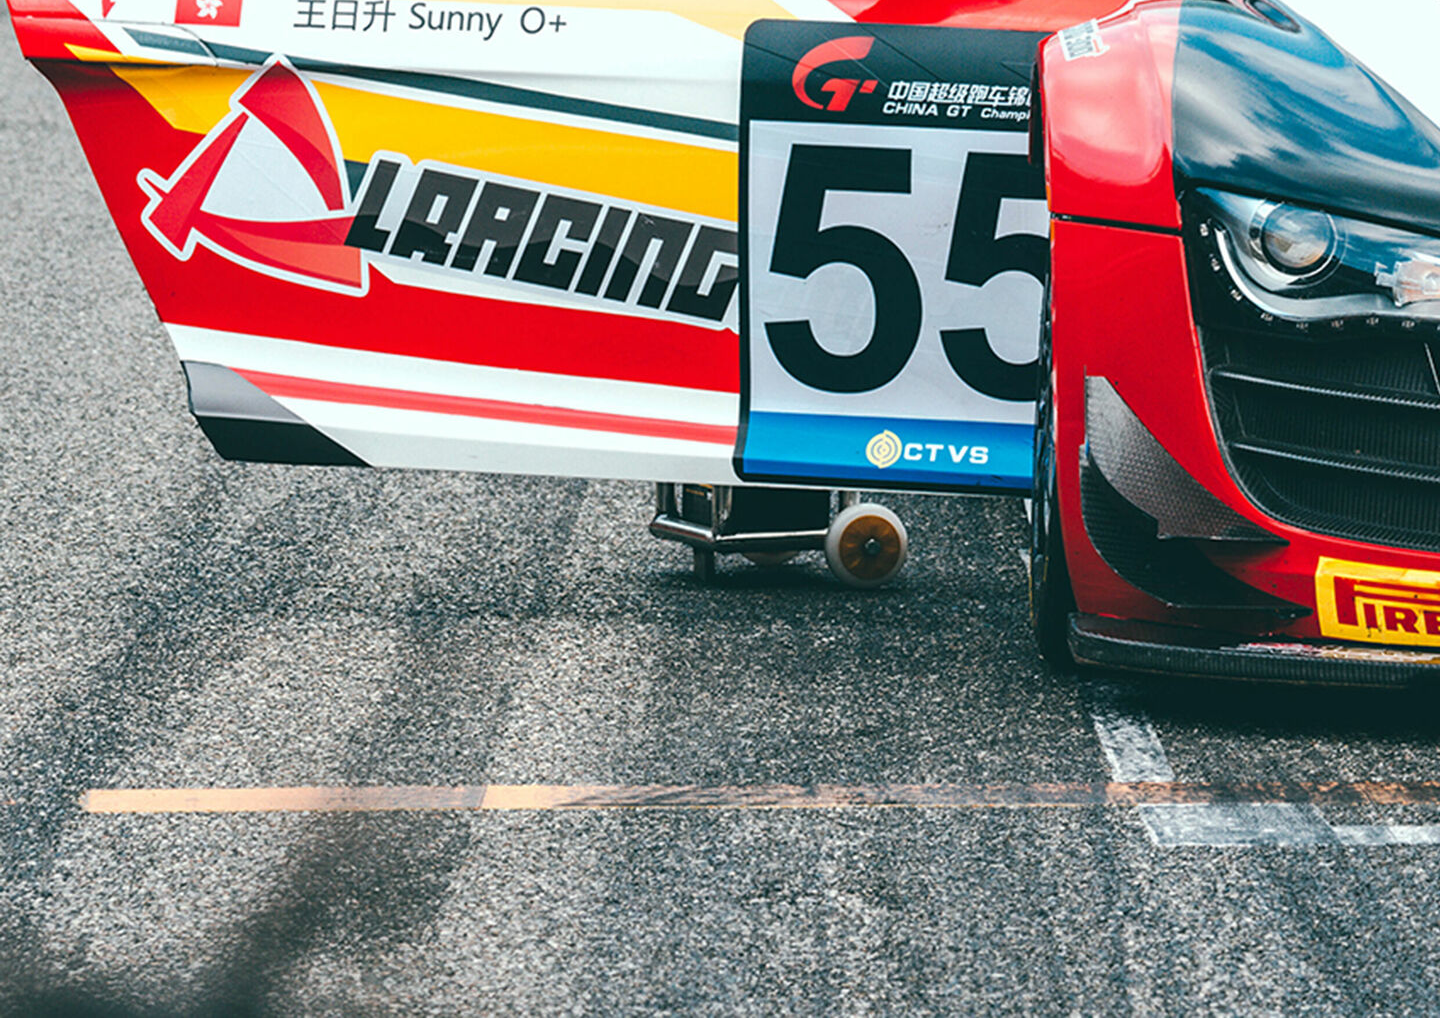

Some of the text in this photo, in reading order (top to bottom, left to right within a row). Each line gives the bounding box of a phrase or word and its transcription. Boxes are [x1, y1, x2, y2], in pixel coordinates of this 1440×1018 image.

[408, 2, 503, 41] Sunny
[520, 7, 567, 34] O+
[882, 101, 938, 117] CHINA
[946, 105, 972, 118] GT
[887, 81, 1031, 107] 中国超级跑车锦
[344, 159, 739, 322] LRACING
[763, 143, 1052, 402] 55
[904, 443, 989, 465] CTVS
